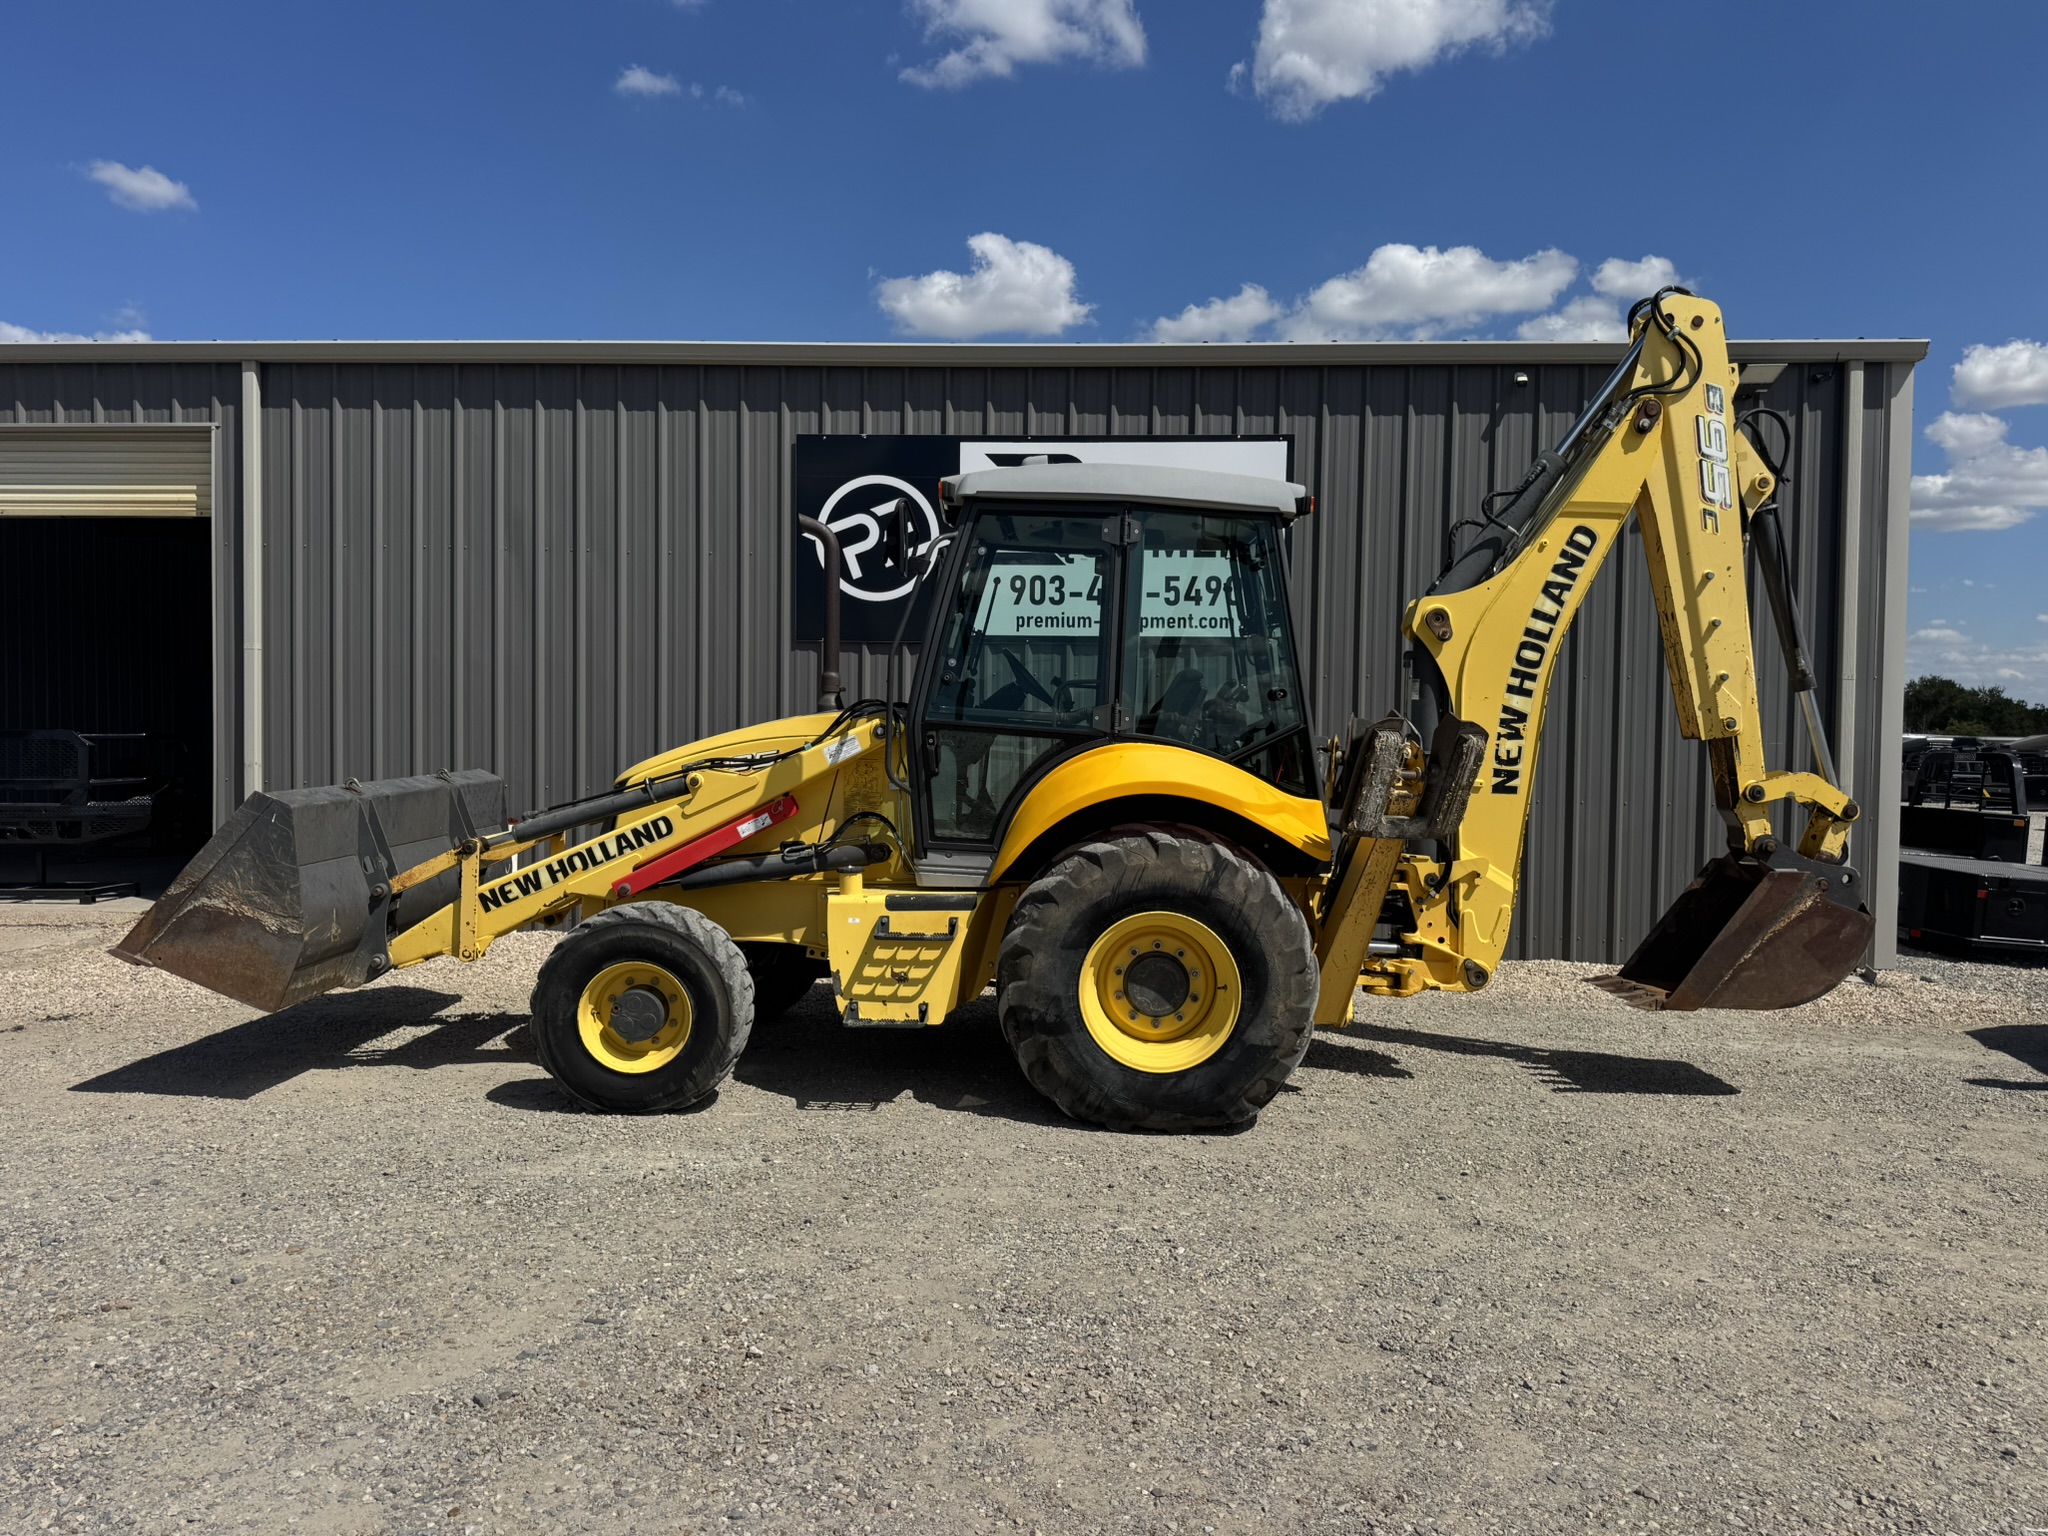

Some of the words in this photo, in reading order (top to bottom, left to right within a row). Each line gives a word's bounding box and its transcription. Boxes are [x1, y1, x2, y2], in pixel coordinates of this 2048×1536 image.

[1506, 525, 1598, 698] HOLLAND
[1491, 704, 1529, 794] NEW
[478, 869, 542, 914] NEW
[545, 815, 674, 884] HOLLAND
